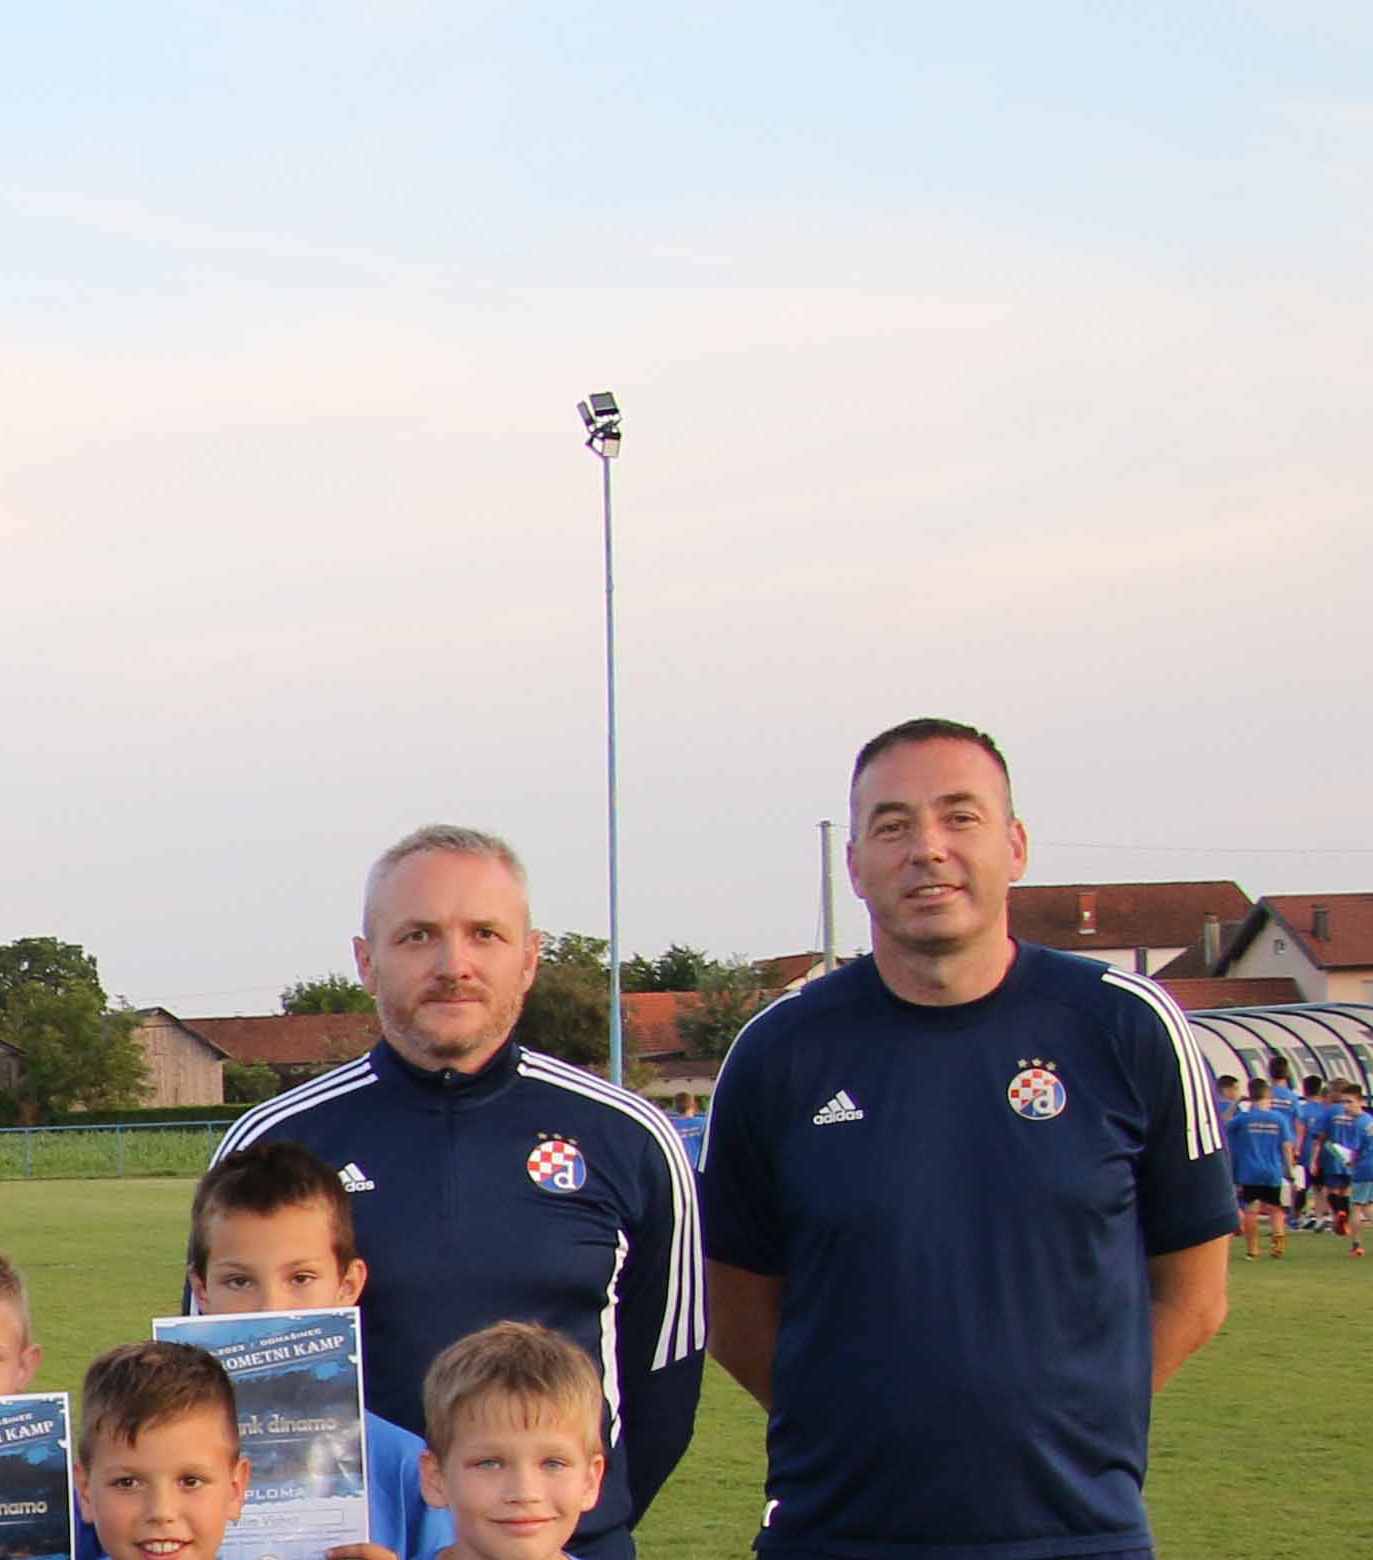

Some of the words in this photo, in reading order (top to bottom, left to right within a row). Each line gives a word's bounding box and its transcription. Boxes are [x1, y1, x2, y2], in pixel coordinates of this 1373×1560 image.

[813, 1109, 863, 1125] adidas
[345, 1179, 375, 1192] das
[293, 1336, 344, 1356] KAMP
[5, 1420, 54, 1441] KAMP
[269, 1413, 336, 1433] dinamo
